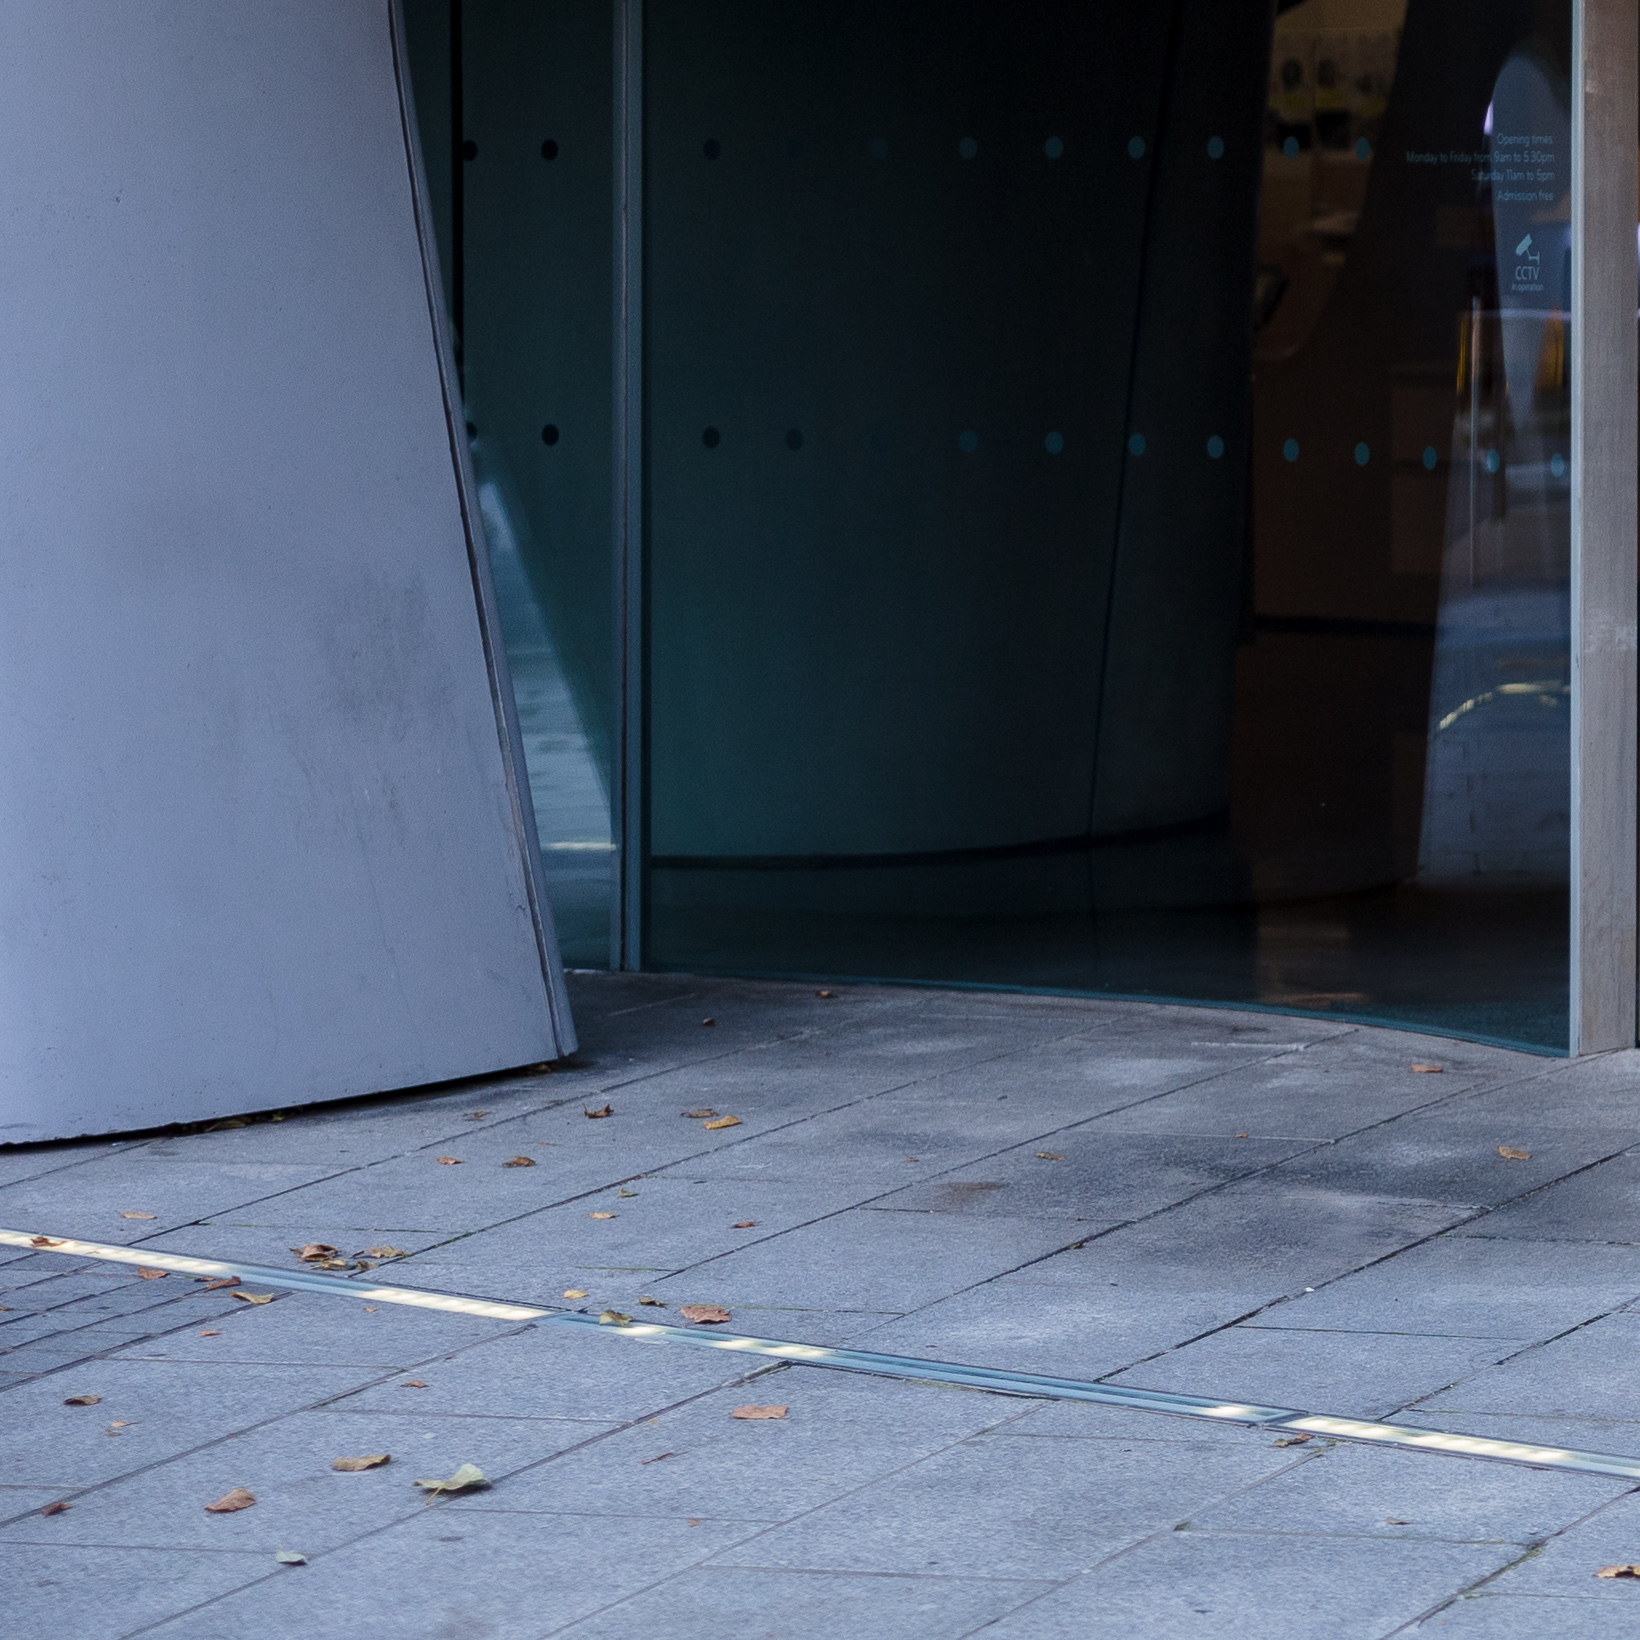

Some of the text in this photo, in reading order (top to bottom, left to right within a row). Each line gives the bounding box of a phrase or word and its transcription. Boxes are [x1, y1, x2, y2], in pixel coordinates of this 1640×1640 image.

[1497, 133, 1554, 147] Opening times
[1406, 150, 1438, 164] Monday
[1440, 151, 1449, 162] to
[1450, 150, 1472, 164] Friday
[1474, 150, 1492, 162] from
[1493, 151, 1513, 162] 9am
[1514, 152, 1522, 162] to
[1471, 168, 1505, 183] Saturday
[1527, 170, 1535, 180] to
[1537, 169, 1555, 183] 5pm
[1497, 190, 1554, 202] Admission free
[1515, 266, 1540, 281] CCTV
